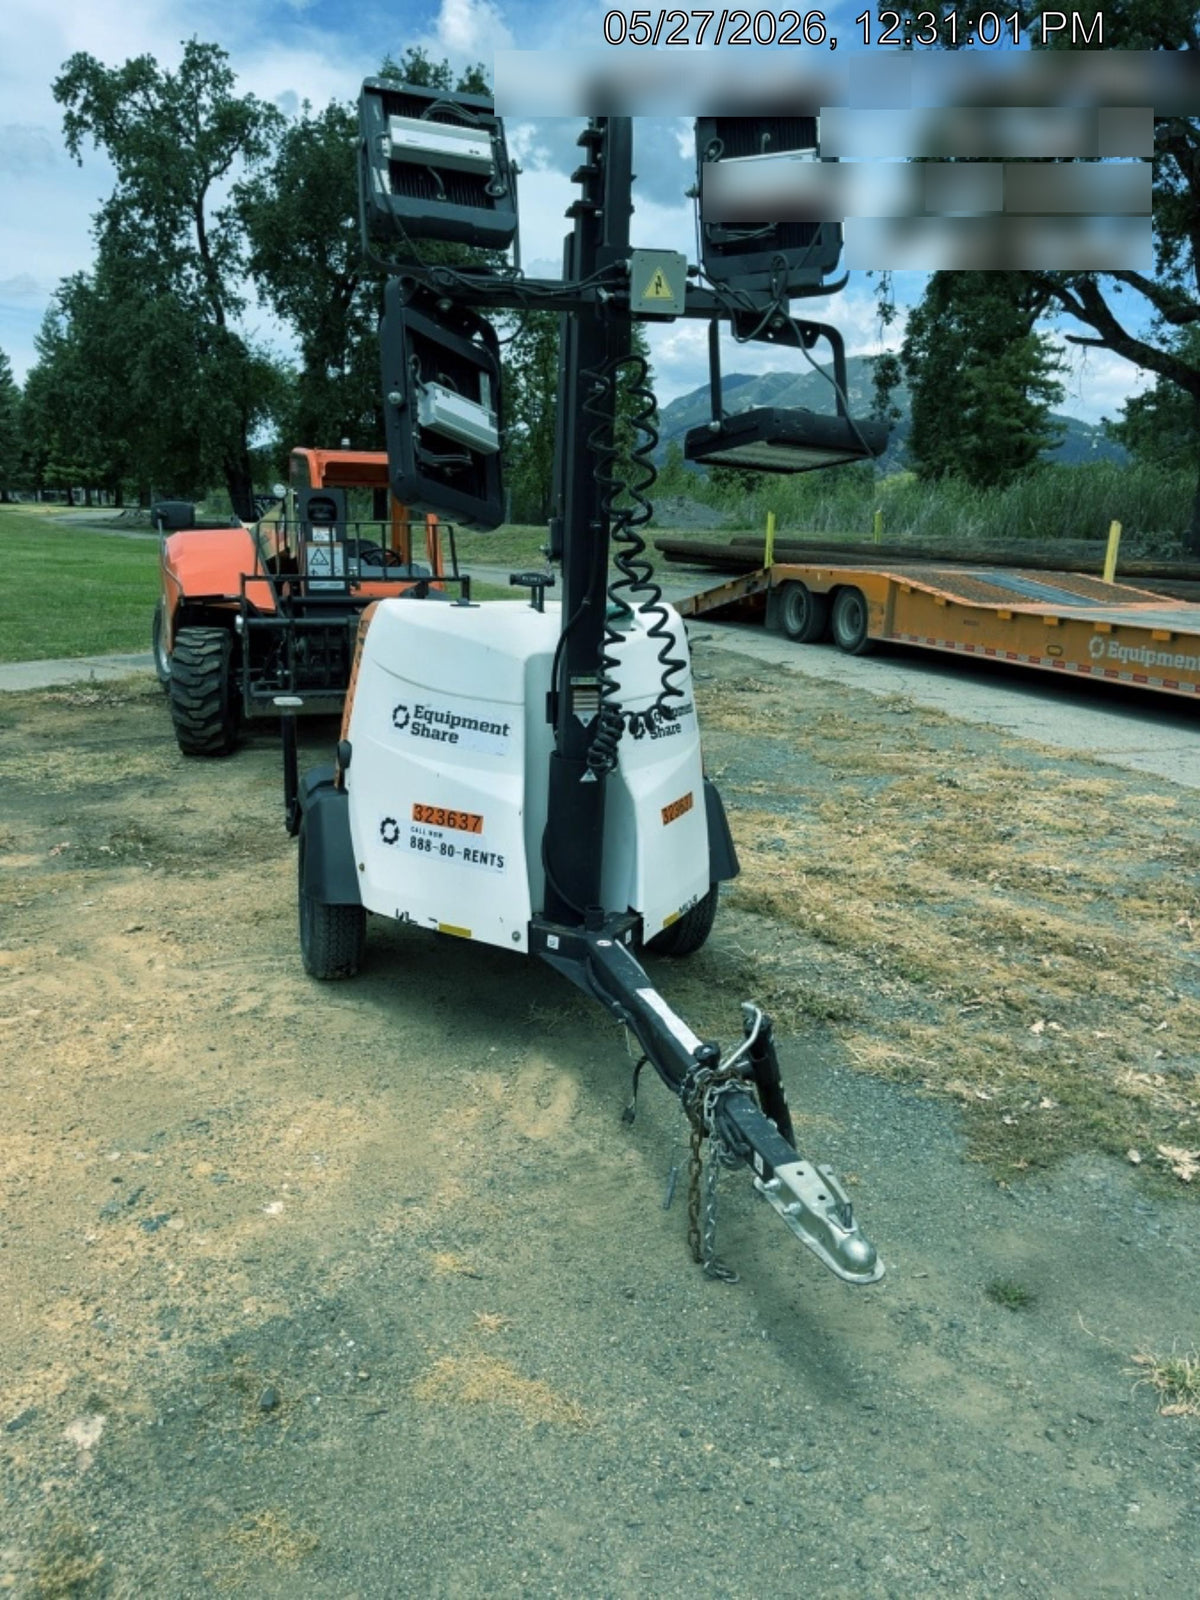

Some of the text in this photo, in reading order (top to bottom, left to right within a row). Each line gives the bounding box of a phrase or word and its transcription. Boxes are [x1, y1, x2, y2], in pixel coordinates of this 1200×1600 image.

[1107, 640, 1200, 671] Equipmen
[410, 721, 460, 744] Share
[413, 704, 511, 737] Equipment
[410, 826, 426, 836] CALL
[413, 803, 482, 833] 323637
[409, 834, 505, 869] 888-80-RENTS
